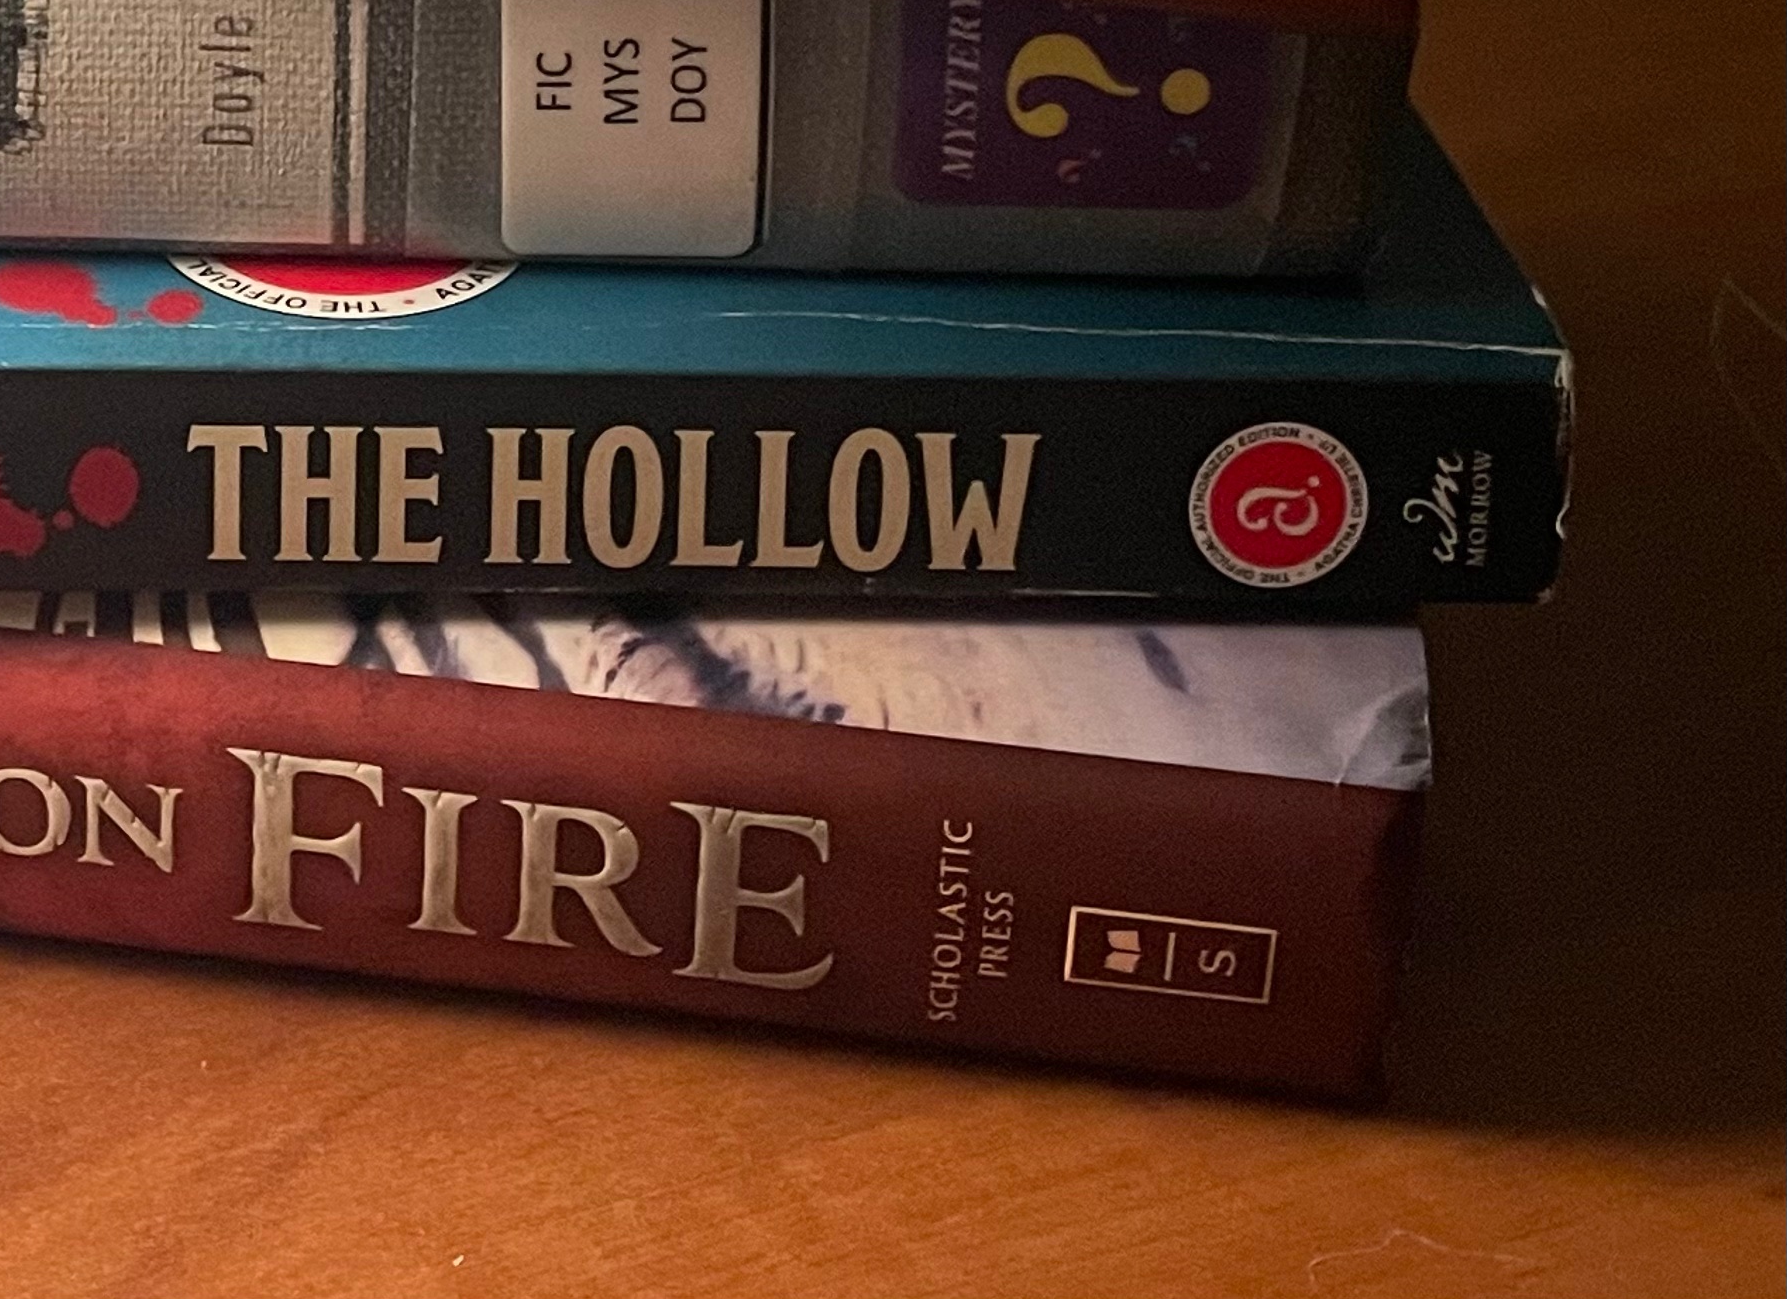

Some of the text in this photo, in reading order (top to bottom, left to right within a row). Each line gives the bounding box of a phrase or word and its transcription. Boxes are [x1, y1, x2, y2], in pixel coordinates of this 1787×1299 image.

[200, 12, 265, 148] Doyle
[536, 51, 573, 112] FIC
[603, 36, 641, 125] MYS
[670, 36, 708, 124] DOY
[188, 258, 385, 313] THE OFFICIAL
[186, 423, 1042, 572] THE HOLLOW
[1464, 449, 1494, 568] MORROW
[226, 746, 835, 990] FIRE
[927, 818, 974, 1023] SCHOLASTIC
[976, 890, 1015, 978] PRESS
